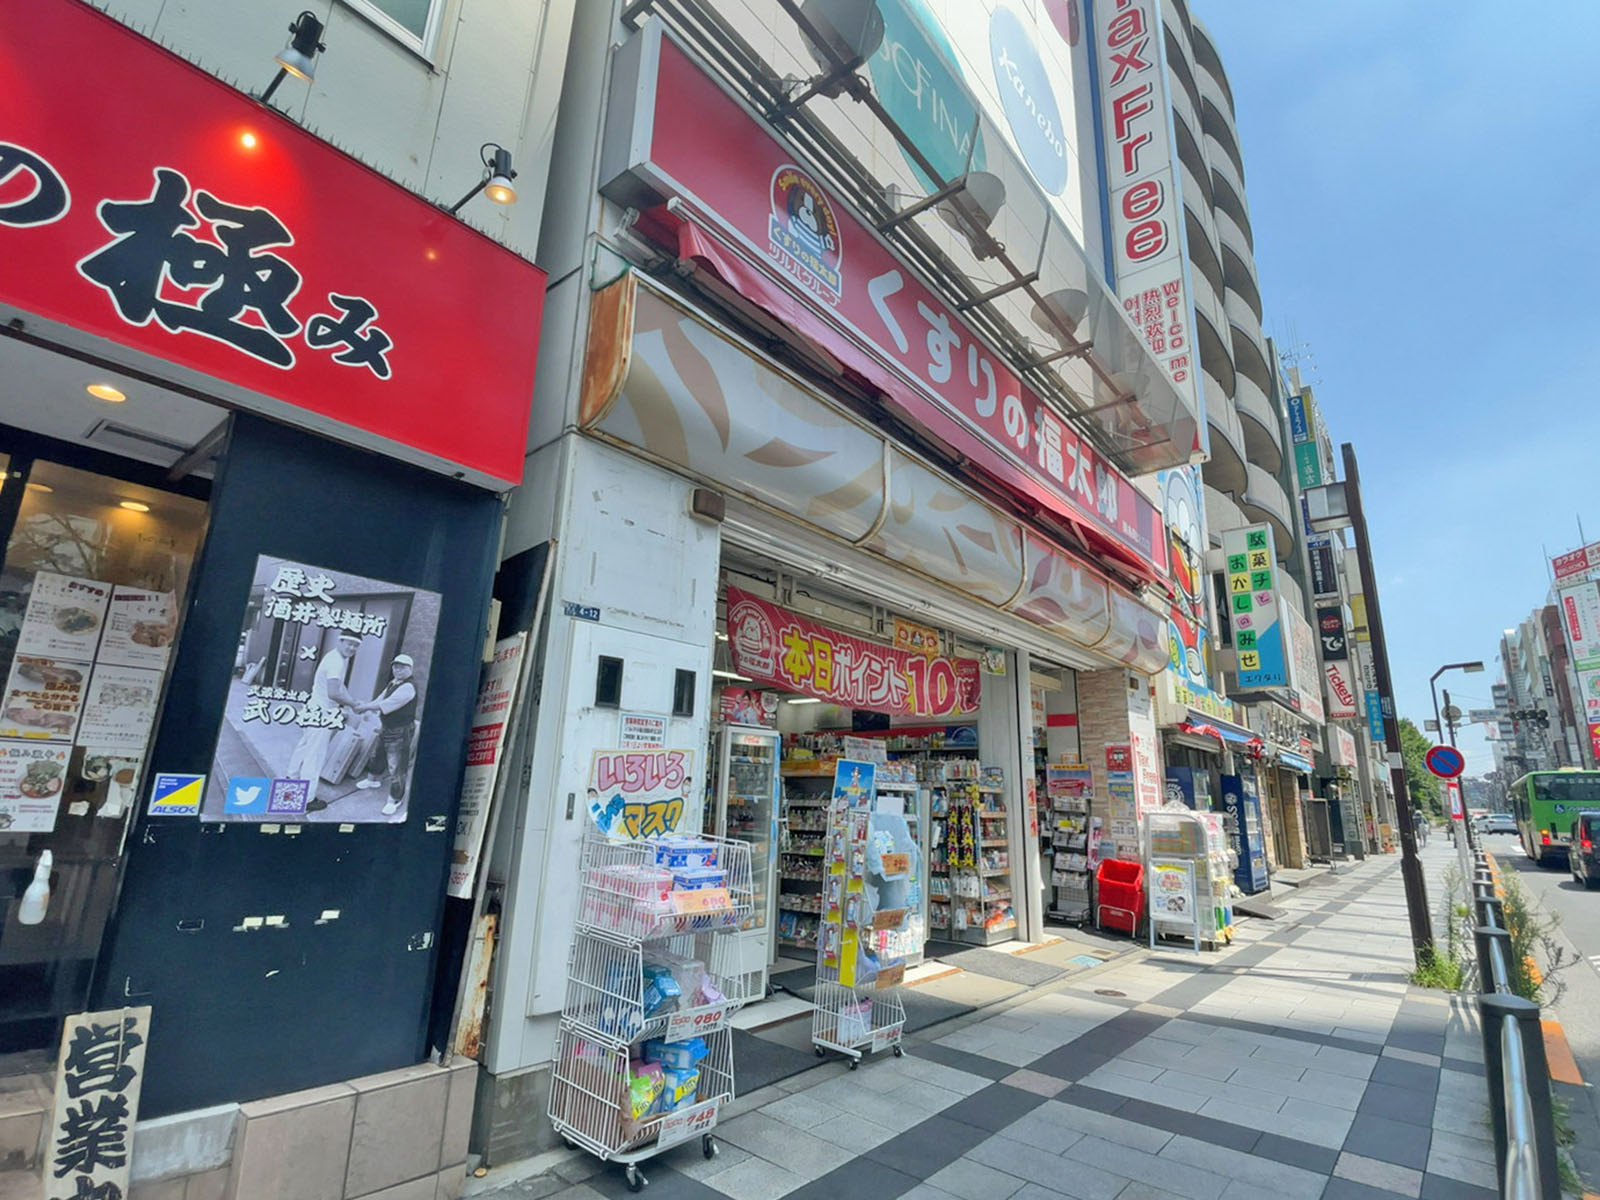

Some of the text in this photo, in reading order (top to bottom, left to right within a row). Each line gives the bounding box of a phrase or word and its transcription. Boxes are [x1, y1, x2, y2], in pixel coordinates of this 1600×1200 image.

[998, 47, 1063, 158] Kanebo
[768, 243, 841, 306] ツルハグループ
[1163, 279, 1189, 383] Welcome
[867, 268, 1118, 524] くすりの福太郎
[270, 567, 336, 603] 歴史
[1250, 532, 1270, 603] 駄菓子と
[1231, 556, 1257, 668] おかしのみせ
[242, 699, 346, 730] 武の極み
[597, 751, 686, 793] いろいろ
[151, 805, 197, 814] ALSOK
[622, 797, 685, 840] マスク
[693, 1010, 722, 1026] 980
[686, 1107, 715, 1127] 748
